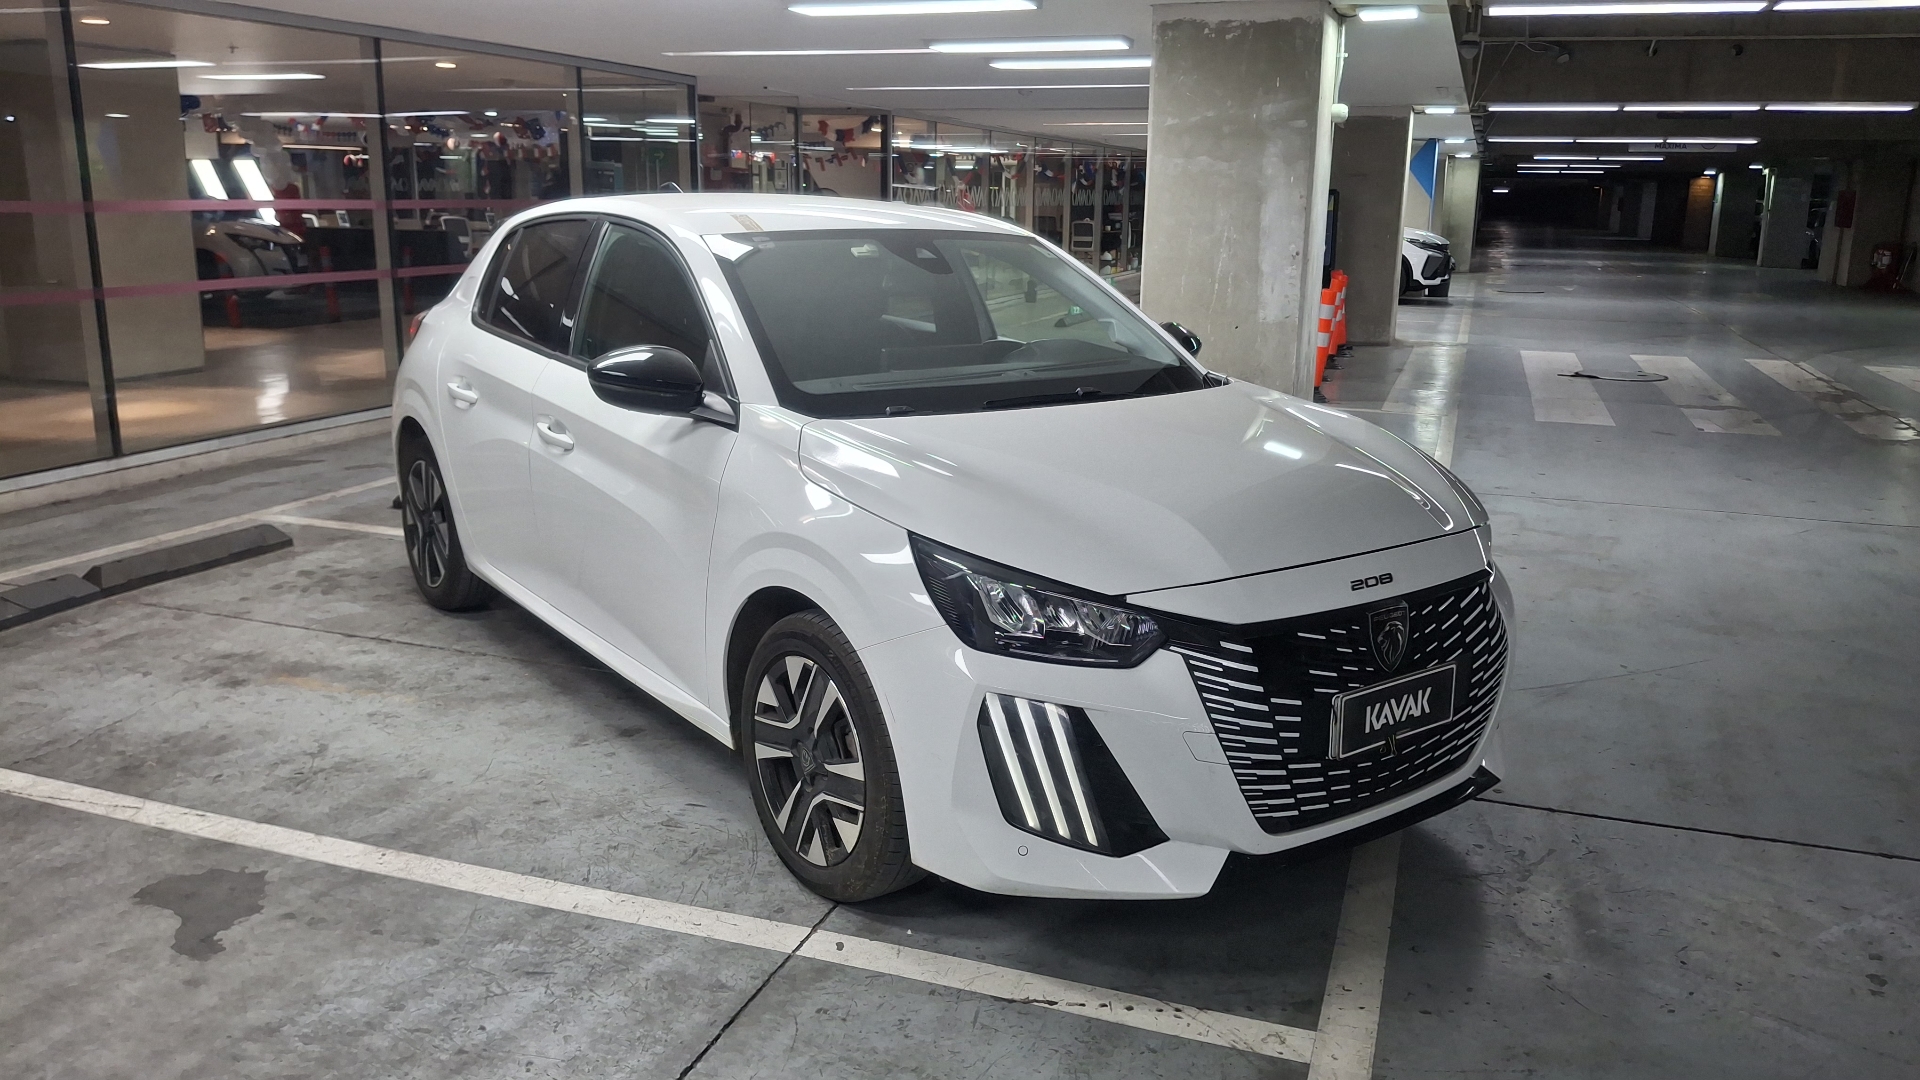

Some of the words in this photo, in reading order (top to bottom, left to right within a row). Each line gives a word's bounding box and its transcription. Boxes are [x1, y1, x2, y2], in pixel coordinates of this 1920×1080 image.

[1350, 572, 1393, 591] 208
[1373, 610, 1405, 622] PEUGEOT
[1365, 687, 1431, 734] KAVAK
